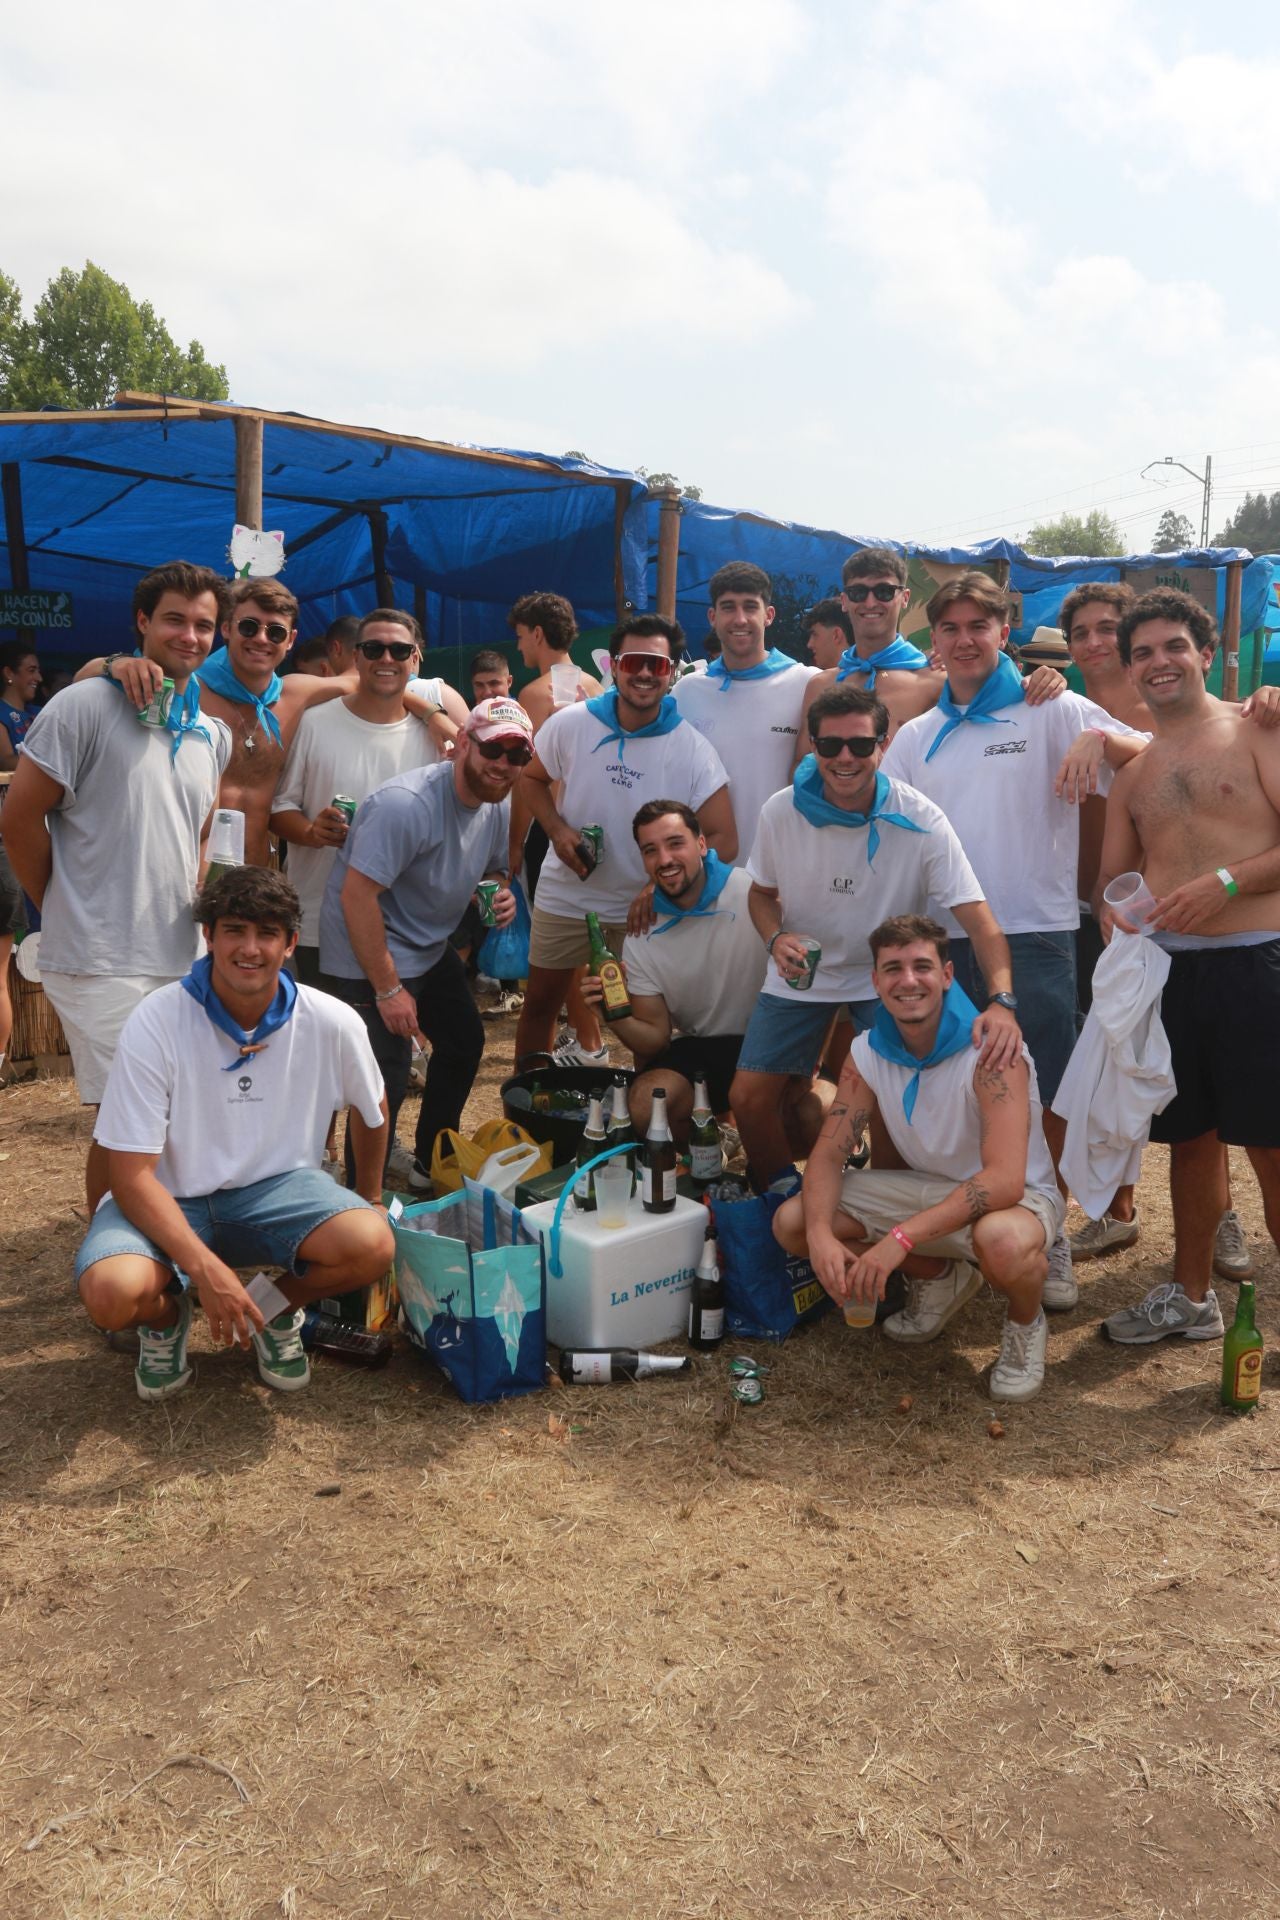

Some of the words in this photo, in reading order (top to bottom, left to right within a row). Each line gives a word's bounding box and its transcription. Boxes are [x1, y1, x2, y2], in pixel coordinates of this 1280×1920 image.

[4, 594, 50, 609] HACEN
[22, 611, 47, 626] CON
[48, 613, 72, 628] LOS
[610, 1291, 629, 1306] La
[634, 1266, 696, 1298] Neverita
